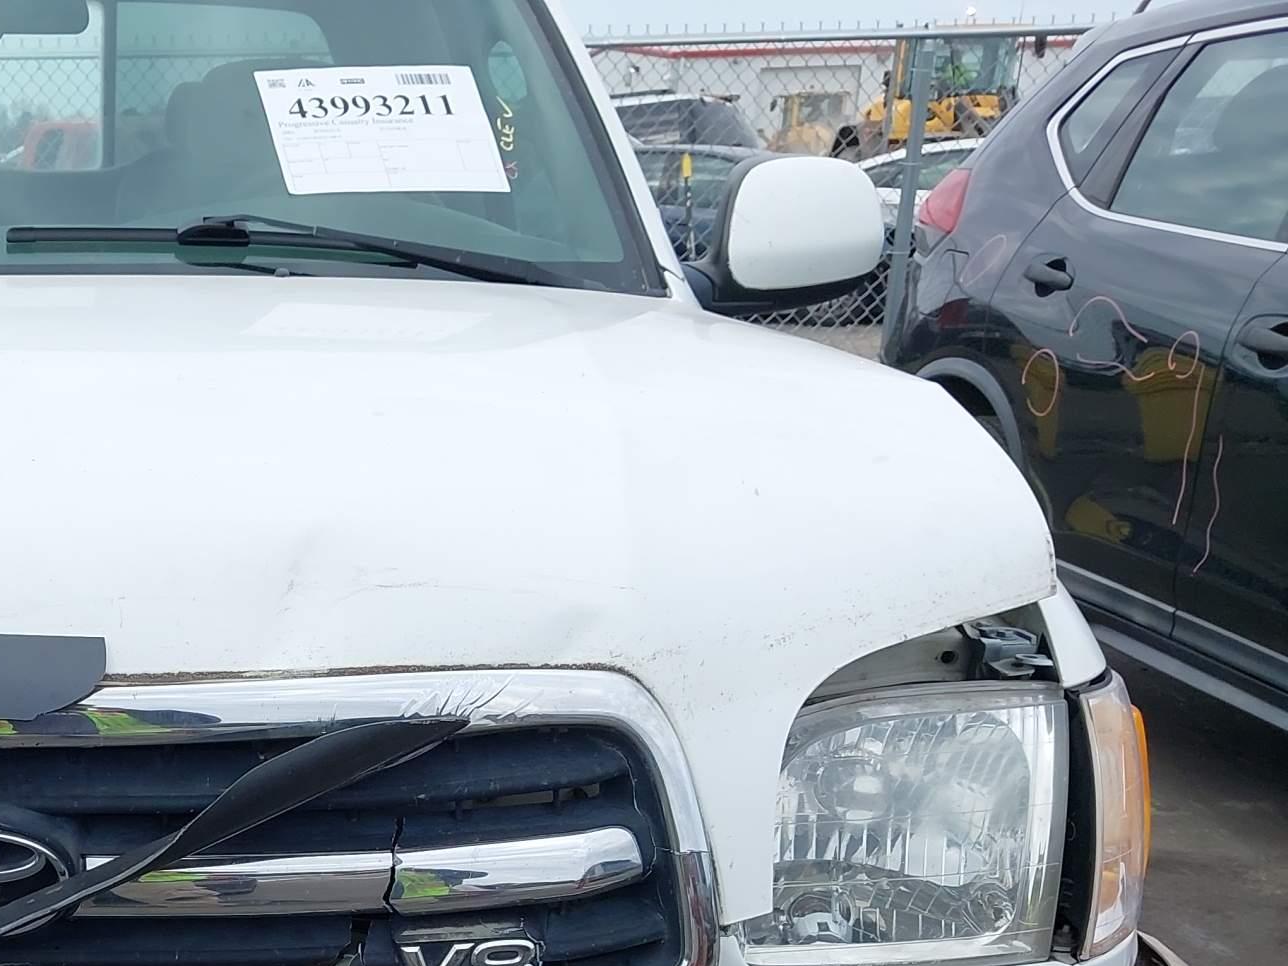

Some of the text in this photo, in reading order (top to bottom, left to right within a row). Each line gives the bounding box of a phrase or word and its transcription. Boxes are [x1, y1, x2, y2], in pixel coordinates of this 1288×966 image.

[288, 94, 454, 119] 43993211
[278, 116, 414, 129] Progressive Casualty Insurance
